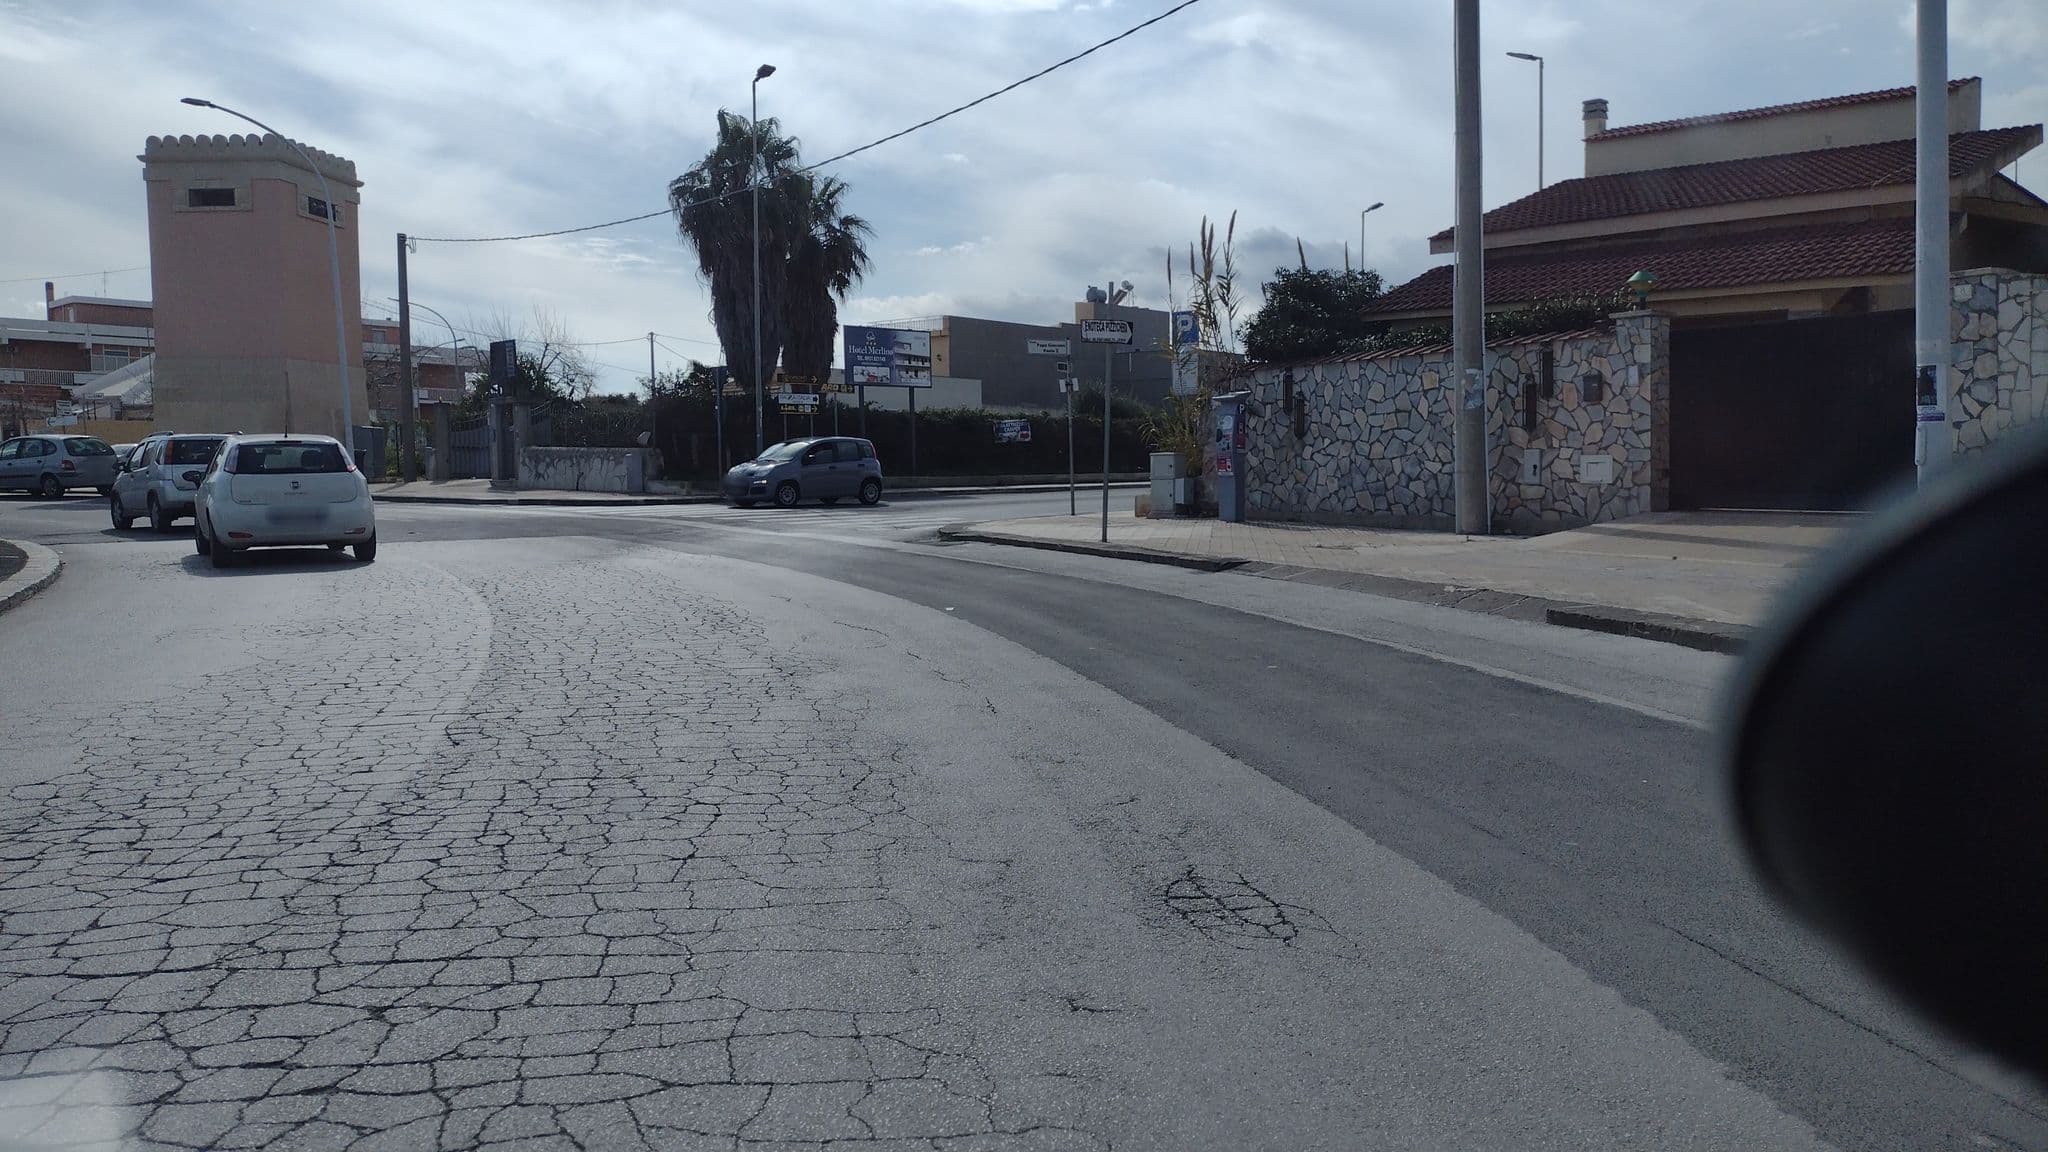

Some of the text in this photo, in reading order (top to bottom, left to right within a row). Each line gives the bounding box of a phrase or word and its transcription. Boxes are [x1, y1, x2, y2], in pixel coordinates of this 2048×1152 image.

[1085, 320, 1105, 332] ENOTECA
[1177, 315, 1193, 338] P
[848, 345, 894, 356] Hotel Merlino
